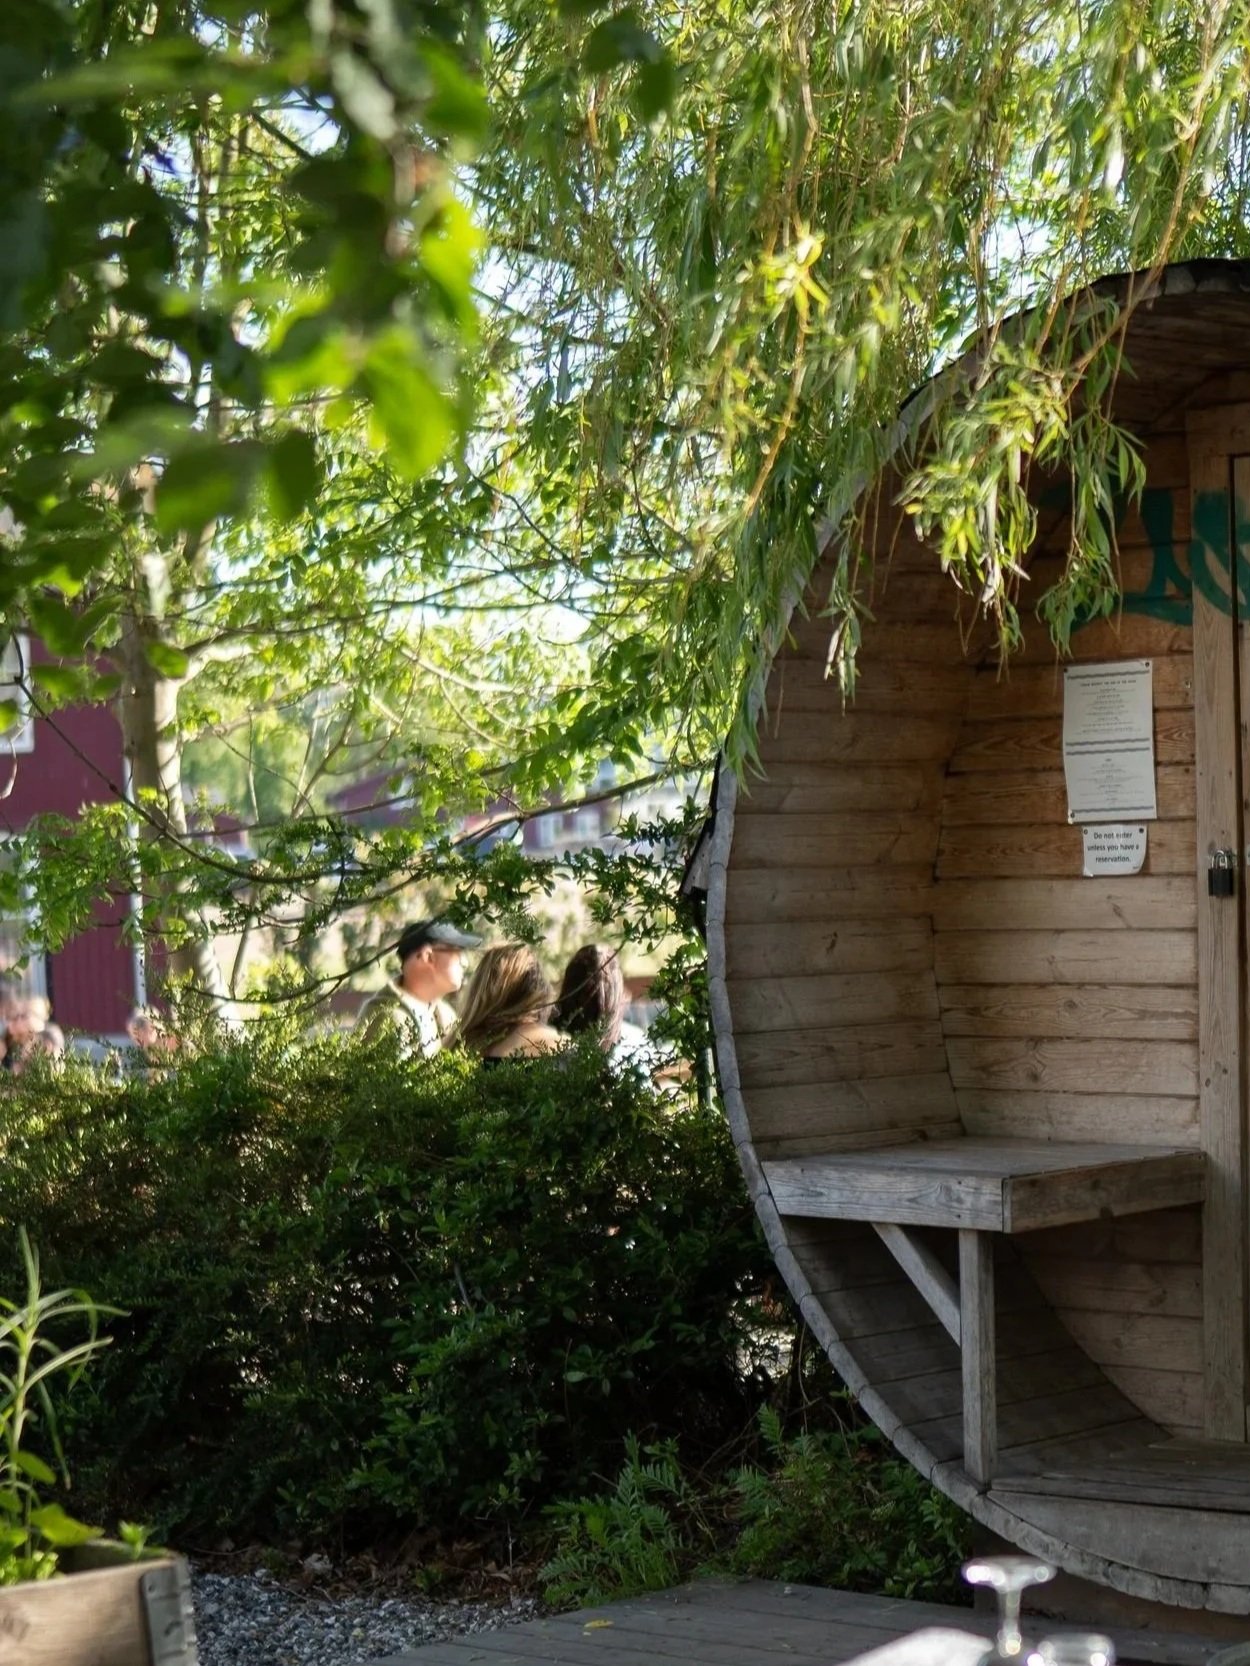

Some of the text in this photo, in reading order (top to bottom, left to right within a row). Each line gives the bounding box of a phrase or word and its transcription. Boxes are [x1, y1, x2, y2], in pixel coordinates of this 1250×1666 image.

[1093, 832, 1102, 840] Do
[1087, 844, 1106, 852] unless
[1106, 845, 1119, 853] you
[1119, 843, 1134, 851] have
[1095, 855, 1131, 863] reservation.
